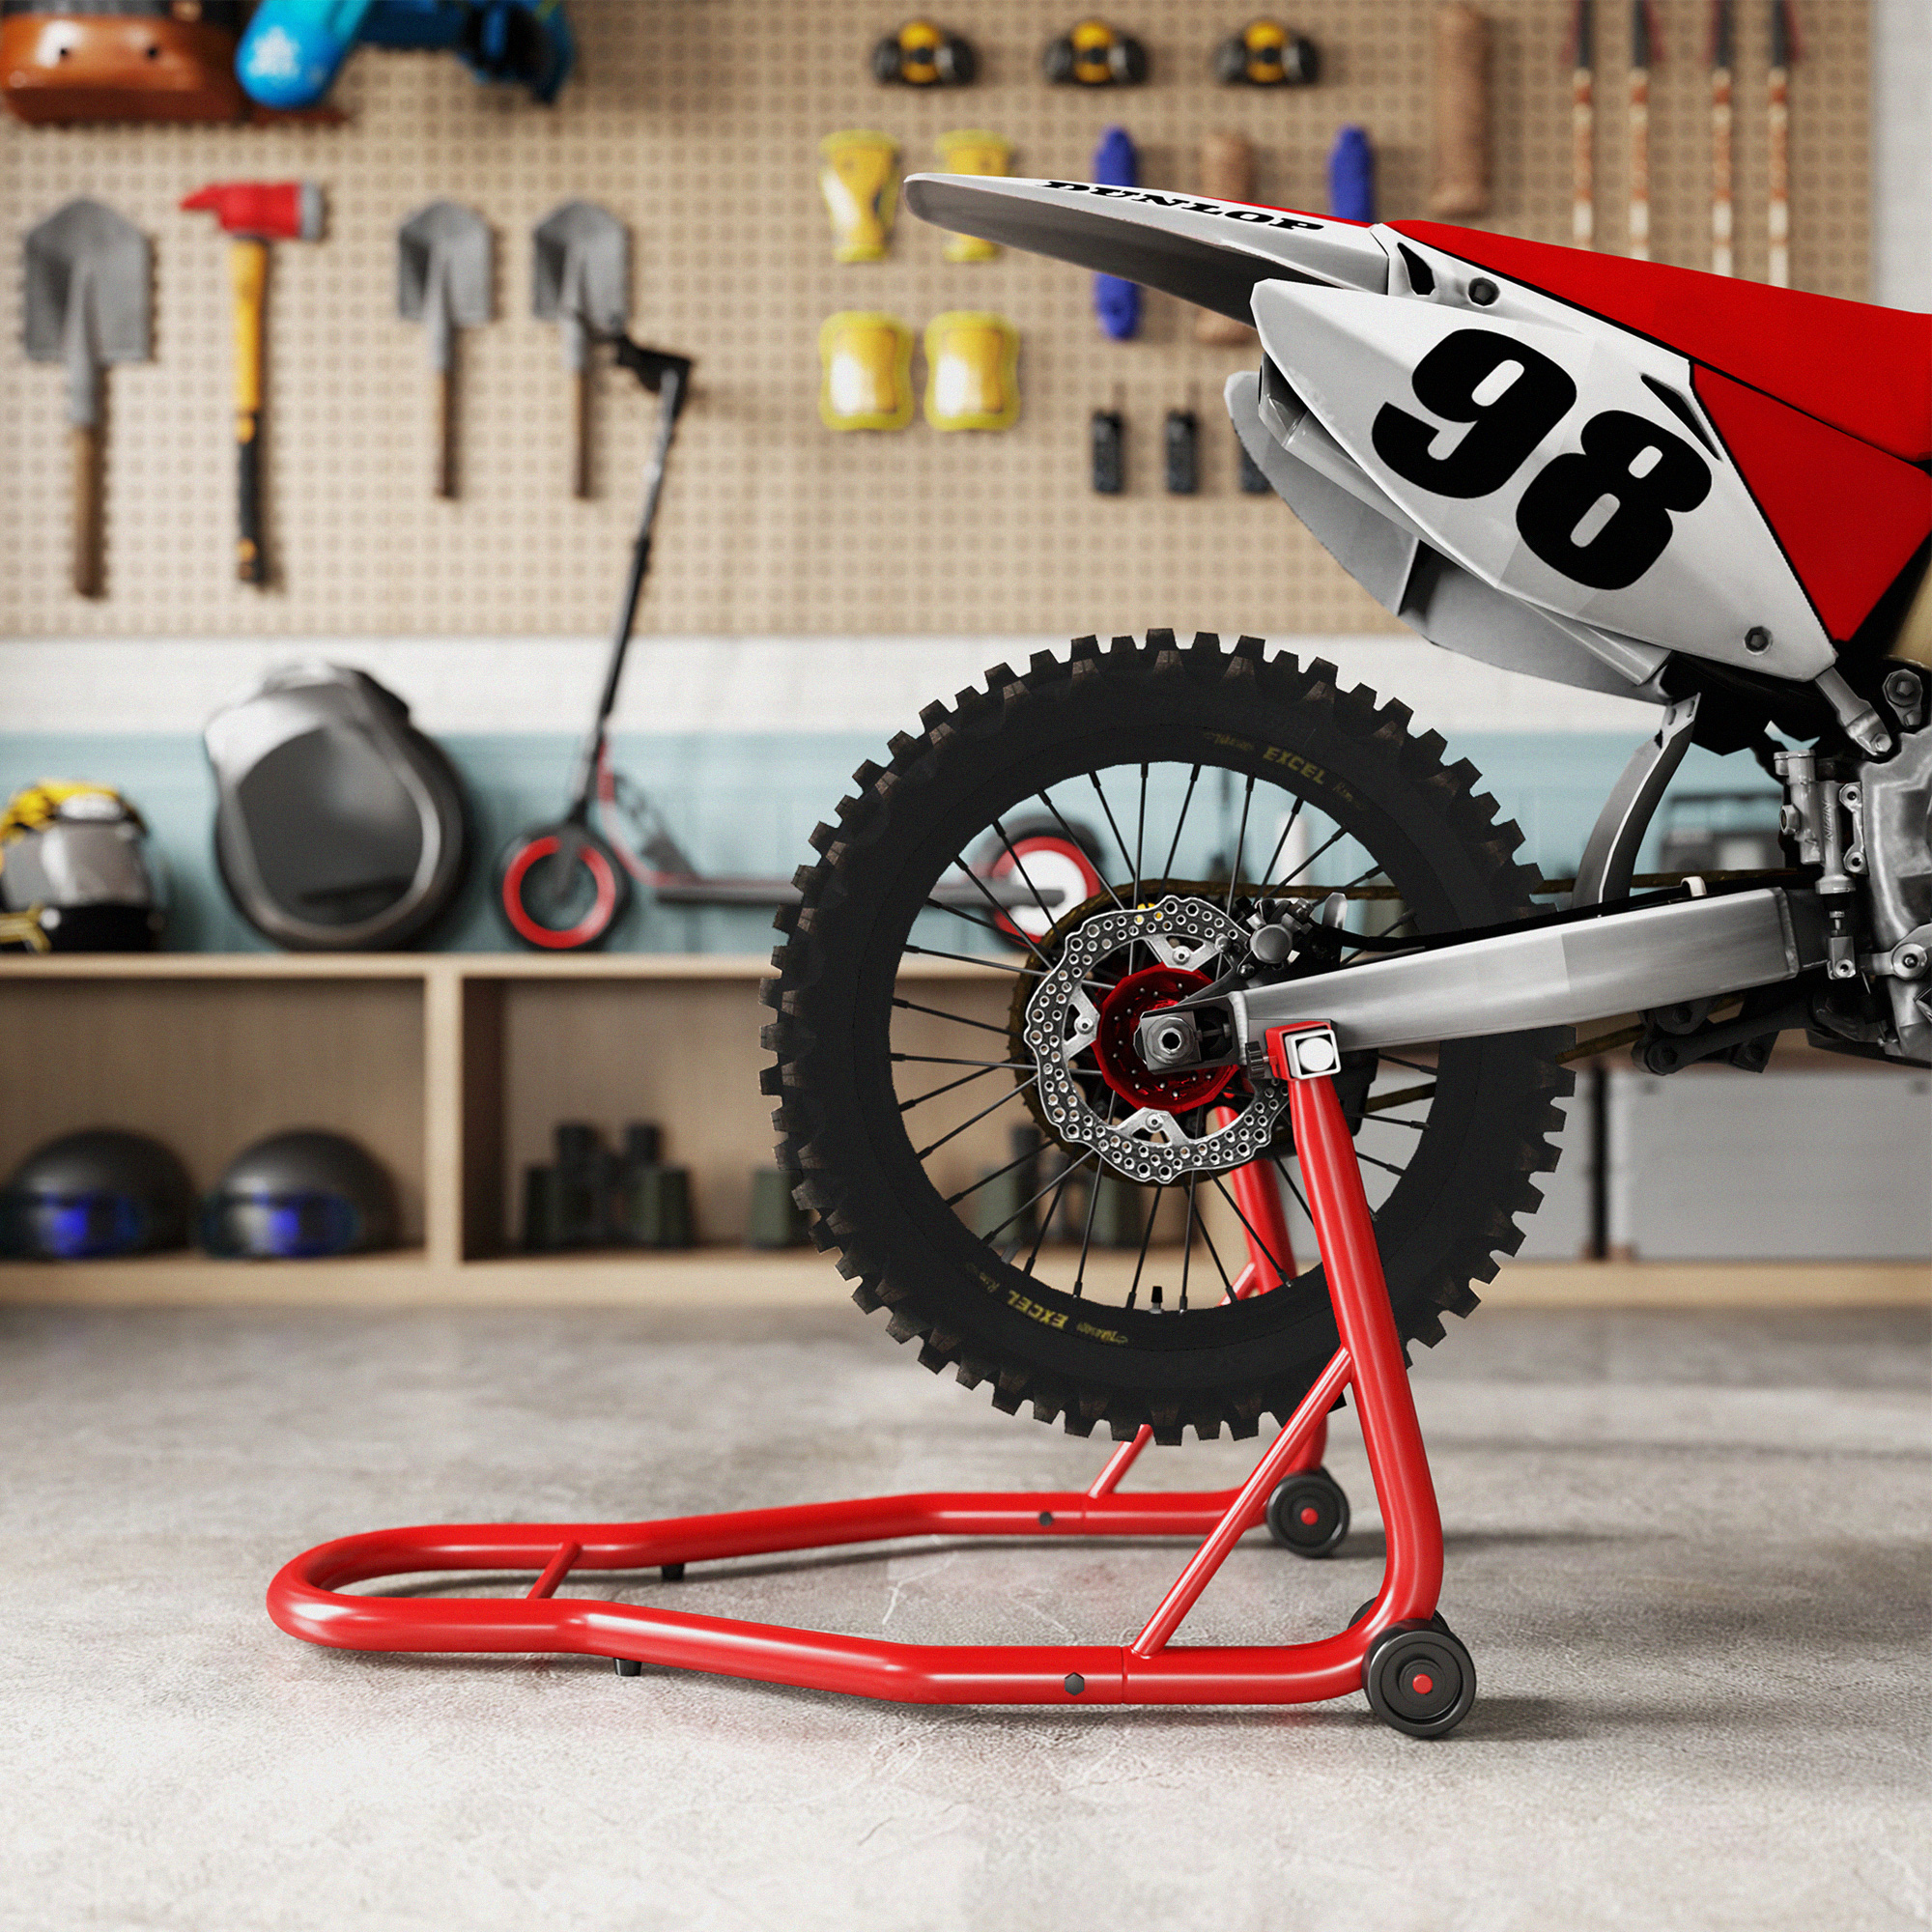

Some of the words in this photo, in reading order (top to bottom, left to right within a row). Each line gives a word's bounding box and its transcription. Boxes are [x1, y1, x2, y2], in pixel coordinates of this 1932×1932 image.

[1037, 181, 1324, 231] DUNLOP
[1372, 328, 1713, 590] 98
[1263, 746, 1325, 785] EXCEL
[1008, 1289, 1069, 1330] EXCEL
